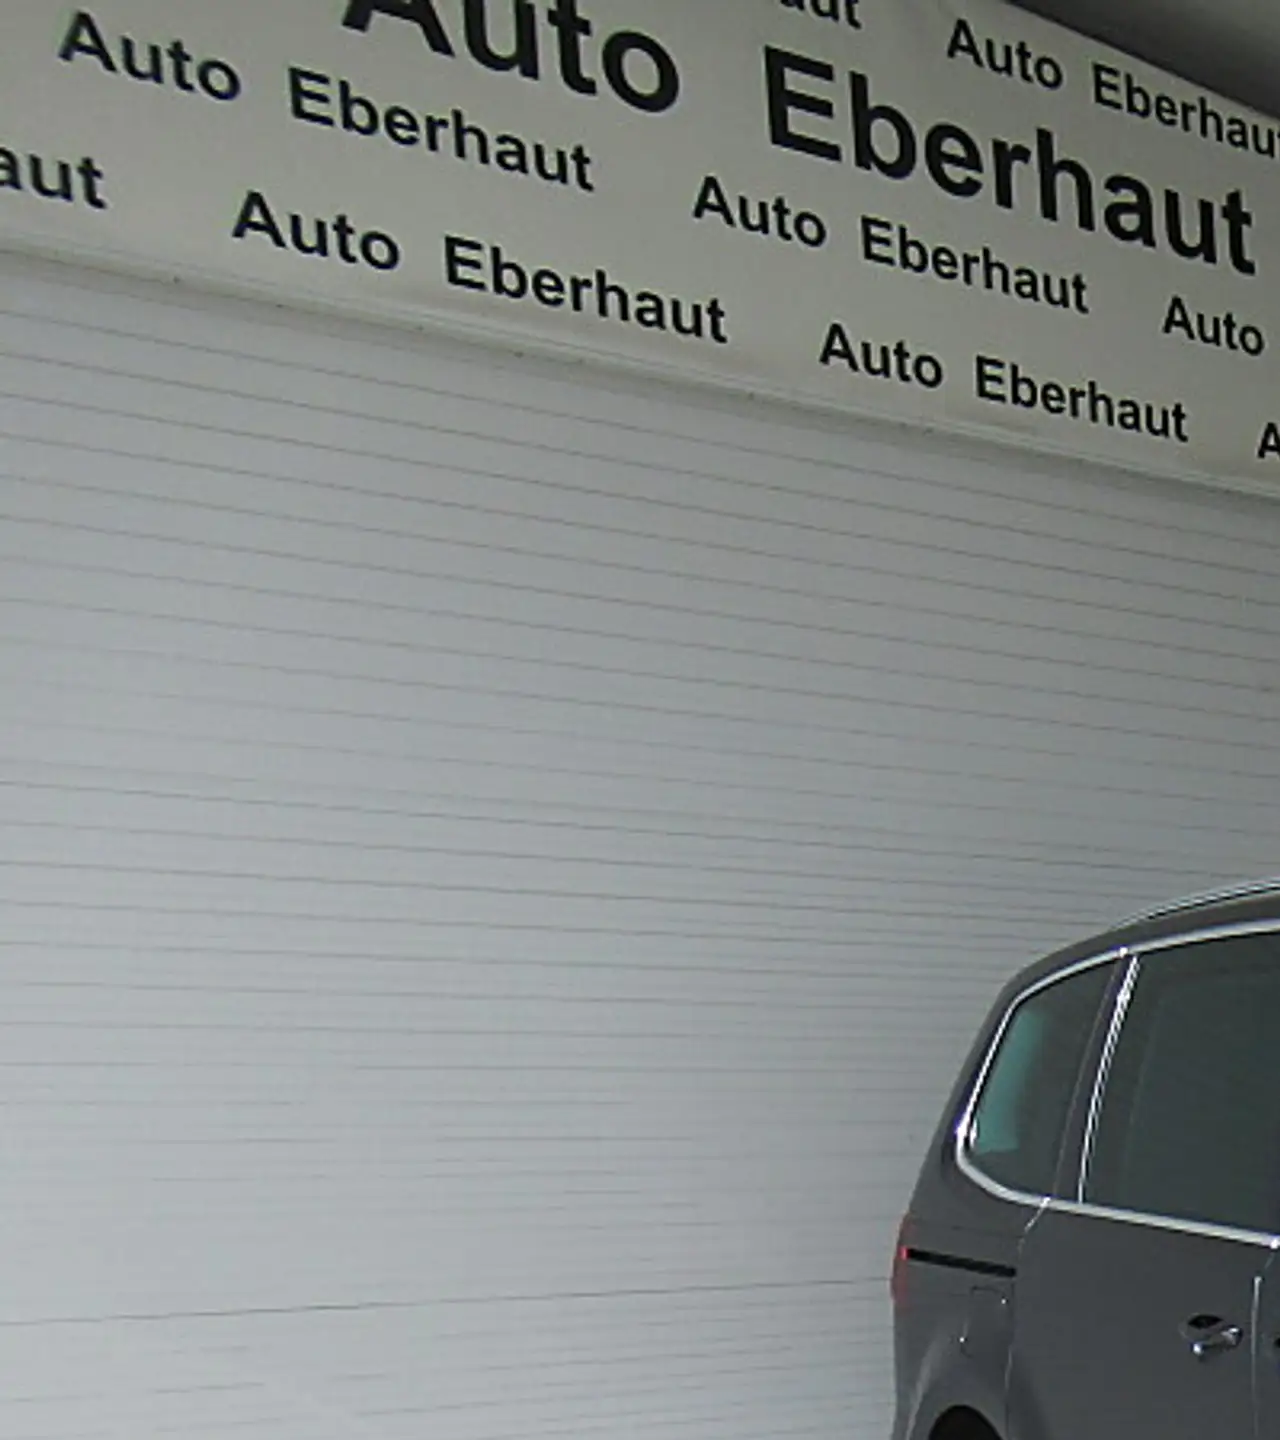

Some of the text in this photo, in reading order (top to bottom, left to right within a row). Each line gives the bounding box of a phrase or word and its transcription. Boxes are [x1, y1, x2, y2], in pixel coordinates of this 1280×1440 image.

[59, 12, 594, 192] Auto Eberhaut
[947, 19, 1062, 89] Auto
[342, 0, 1256, 275] Auto Eberhaut
[232, 191, 727, 343] Auto Eberhaut
[693, 176, 1088, 314] Auto Eberhaut
[819, 324, 1188, 442] Auto Eberhaut
[1163, 296, 1264, 356] Auto
